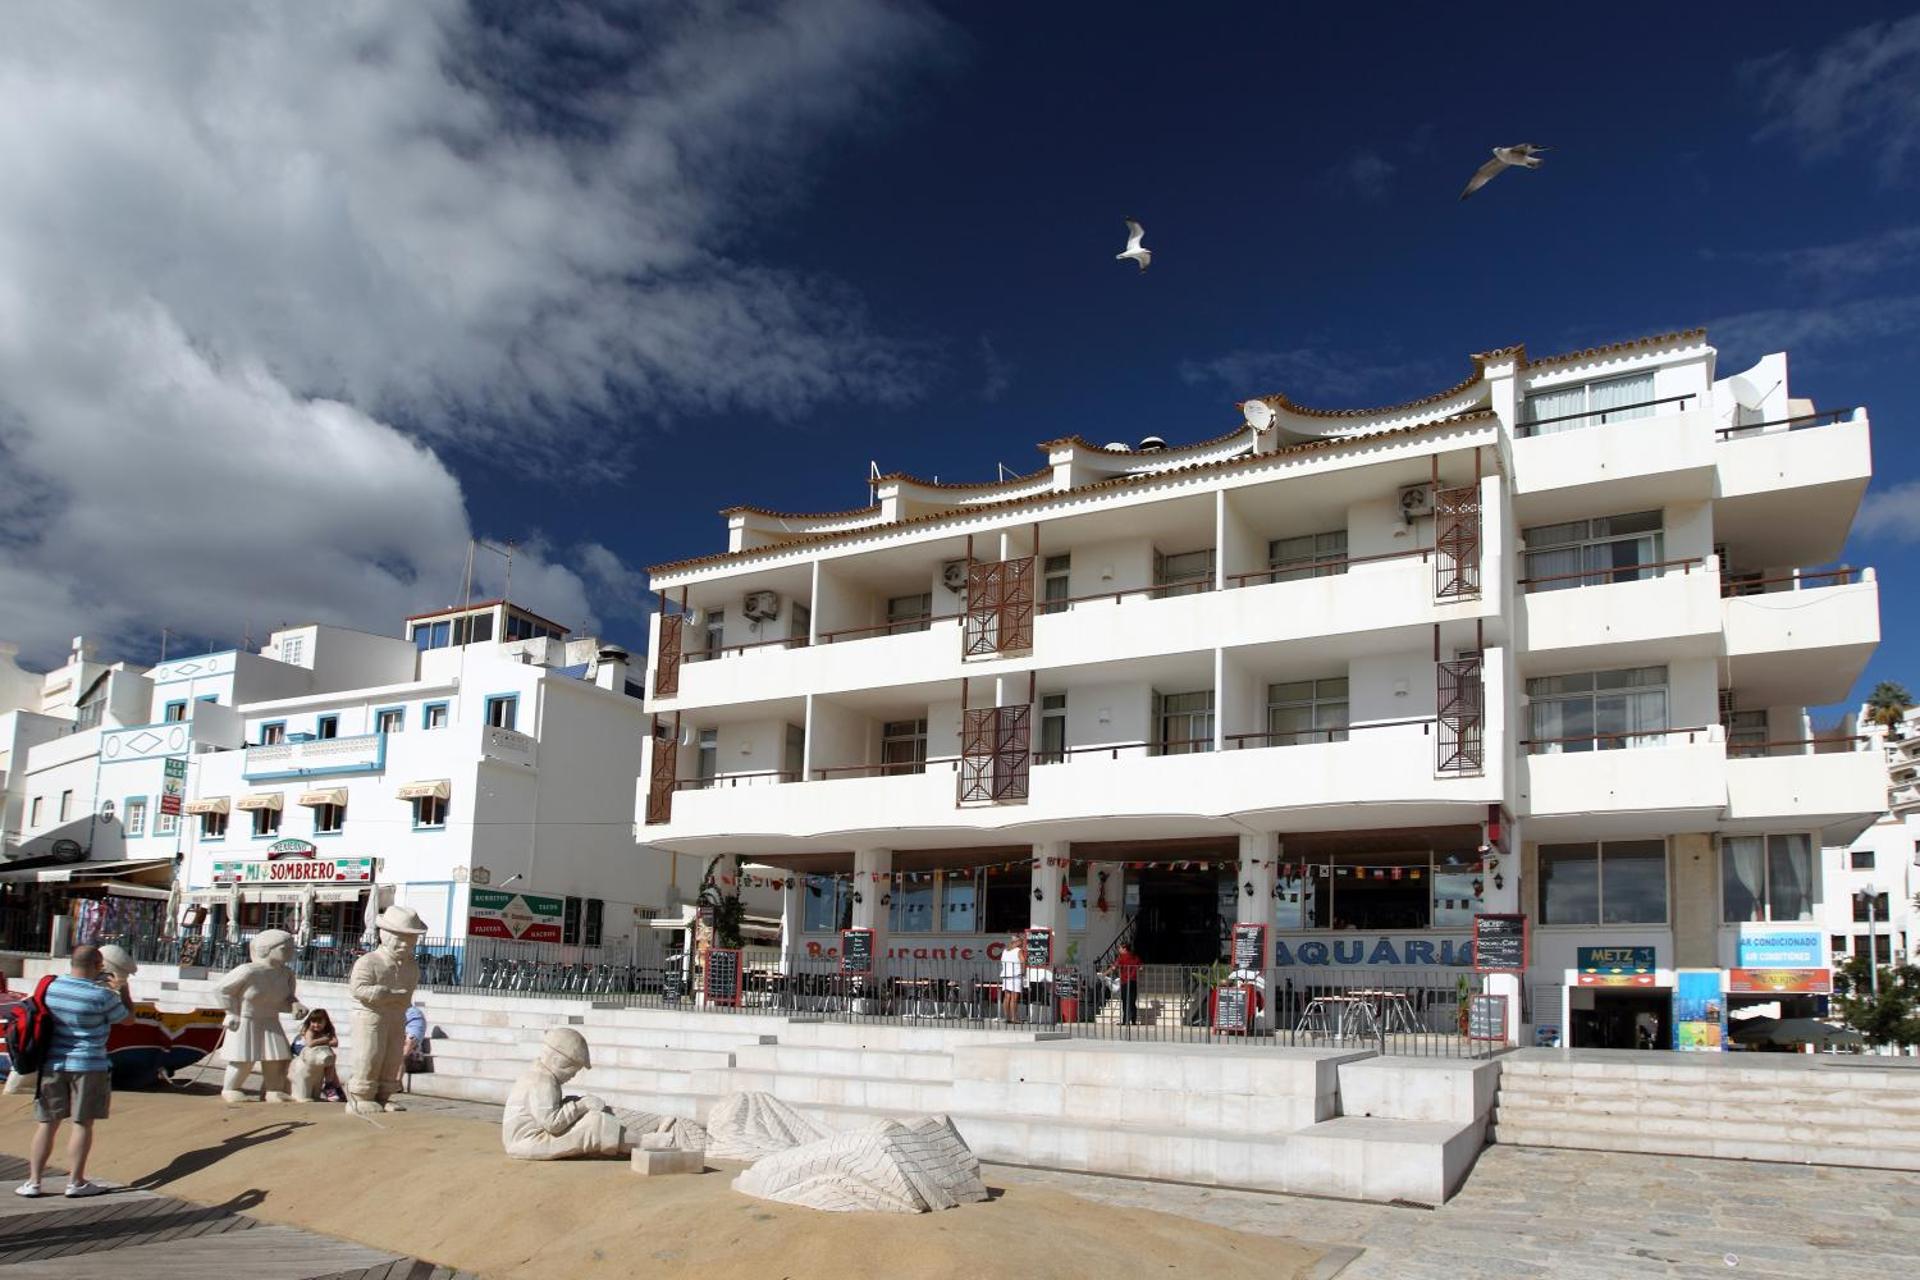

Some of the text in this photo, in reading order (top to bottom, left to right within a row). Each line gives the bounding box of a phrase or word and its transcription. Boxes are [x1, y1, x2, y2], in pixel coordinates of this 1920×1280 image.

[246, 864, 260, 880] MI
[269, 862, 335, 881] SOMBRERO
[1754, 937, 1818, 947] CONDICIONADO
[1591, 949, 1634, 962] METZ
